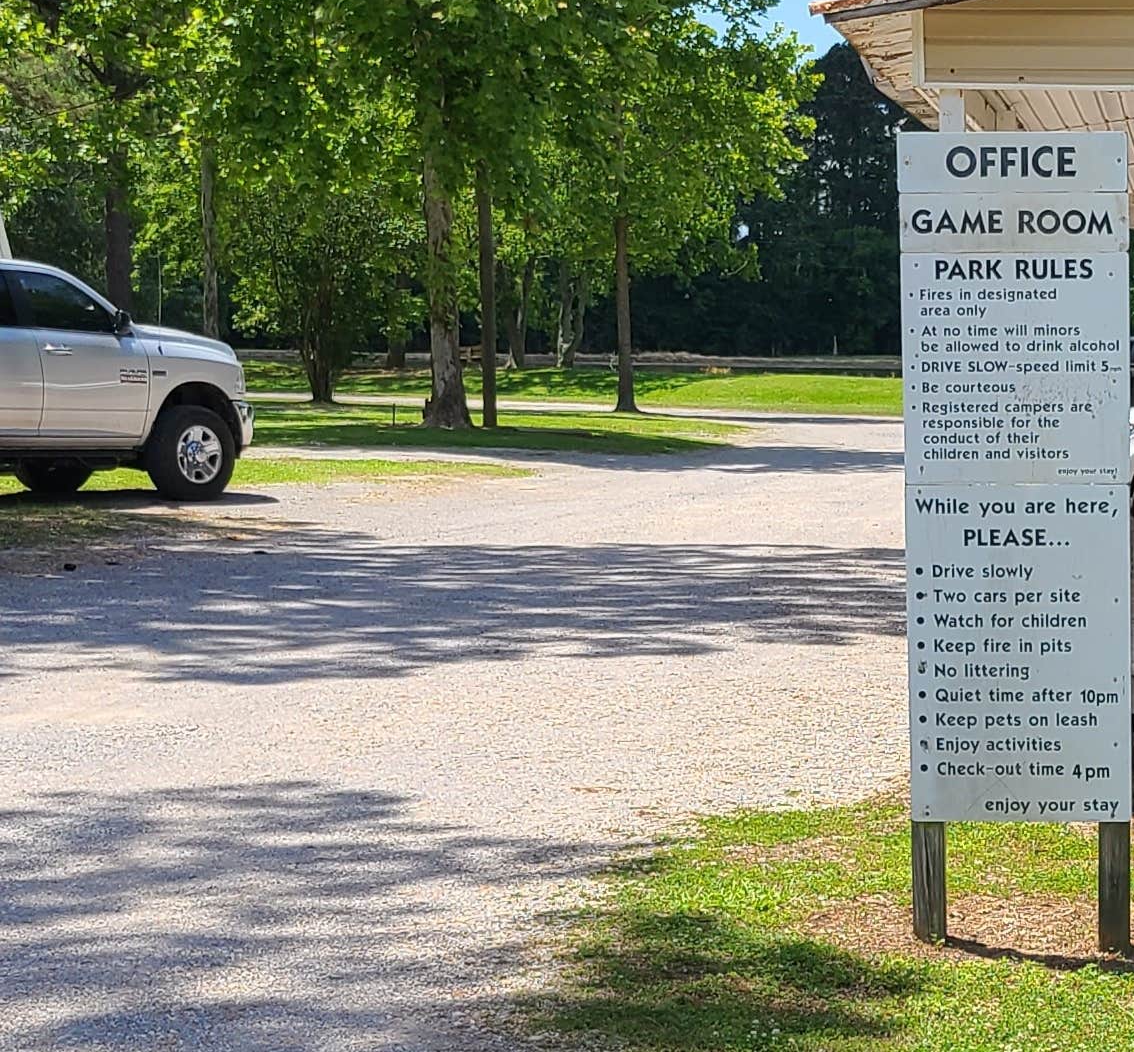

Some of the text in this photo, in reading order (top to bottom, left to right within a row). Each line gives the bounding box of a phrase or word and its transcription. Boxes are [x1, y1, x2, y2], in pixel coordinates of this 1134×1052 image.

[946, 146, 1077, 178] OFFICE
[911, 209, 1113, 234] GAME ROOM
[935, 259, 1093, 280] PARK RULES
[920, 288, 1057, 302] Fires in designated
[920, 305, 987, 318] area only
[922, 324, 1080, 337] At no time will minors
[921, 340, 1120, 352] be allowed to drink alcohol
[922, 362, 961, 373] DRIVE
[1066, 361, 1096, 372] limit
[922, 382, 1015, 393] Be courteous
[922, 402, 1092, 415] Registered campers are
[923, 417, 1060, 430] responsible for the
[924, 433, 1040, 444] conduct of their
[924, 448, 1069, 460] children and visitors
[1058, 468, 1078, 476] enjoy
[915, 499, 1118, 517] While you are here,
[964, 529, 1070, 547] PLEASE...
[933, 564, 1033, 581] Drive slowly
[934, 590, 1081, 606] Two cars per site
[934, 614, 1087, 628] Watch for children
[934, 639, 1072, 656] Keep fire in pits
[934, 663, 1030, 680] No littering
[936, 689, 1119, 706] Quiet time after 10pm
[936, 713, 1098, 729] Keep pets on leash
[936, 738, 1062, 754] Enjoy activities
[937, 762, 1022, 776] Check-out
[1029, 762, 1064, 776] time
[985, 798, 1119, 817] enjoy your stay
